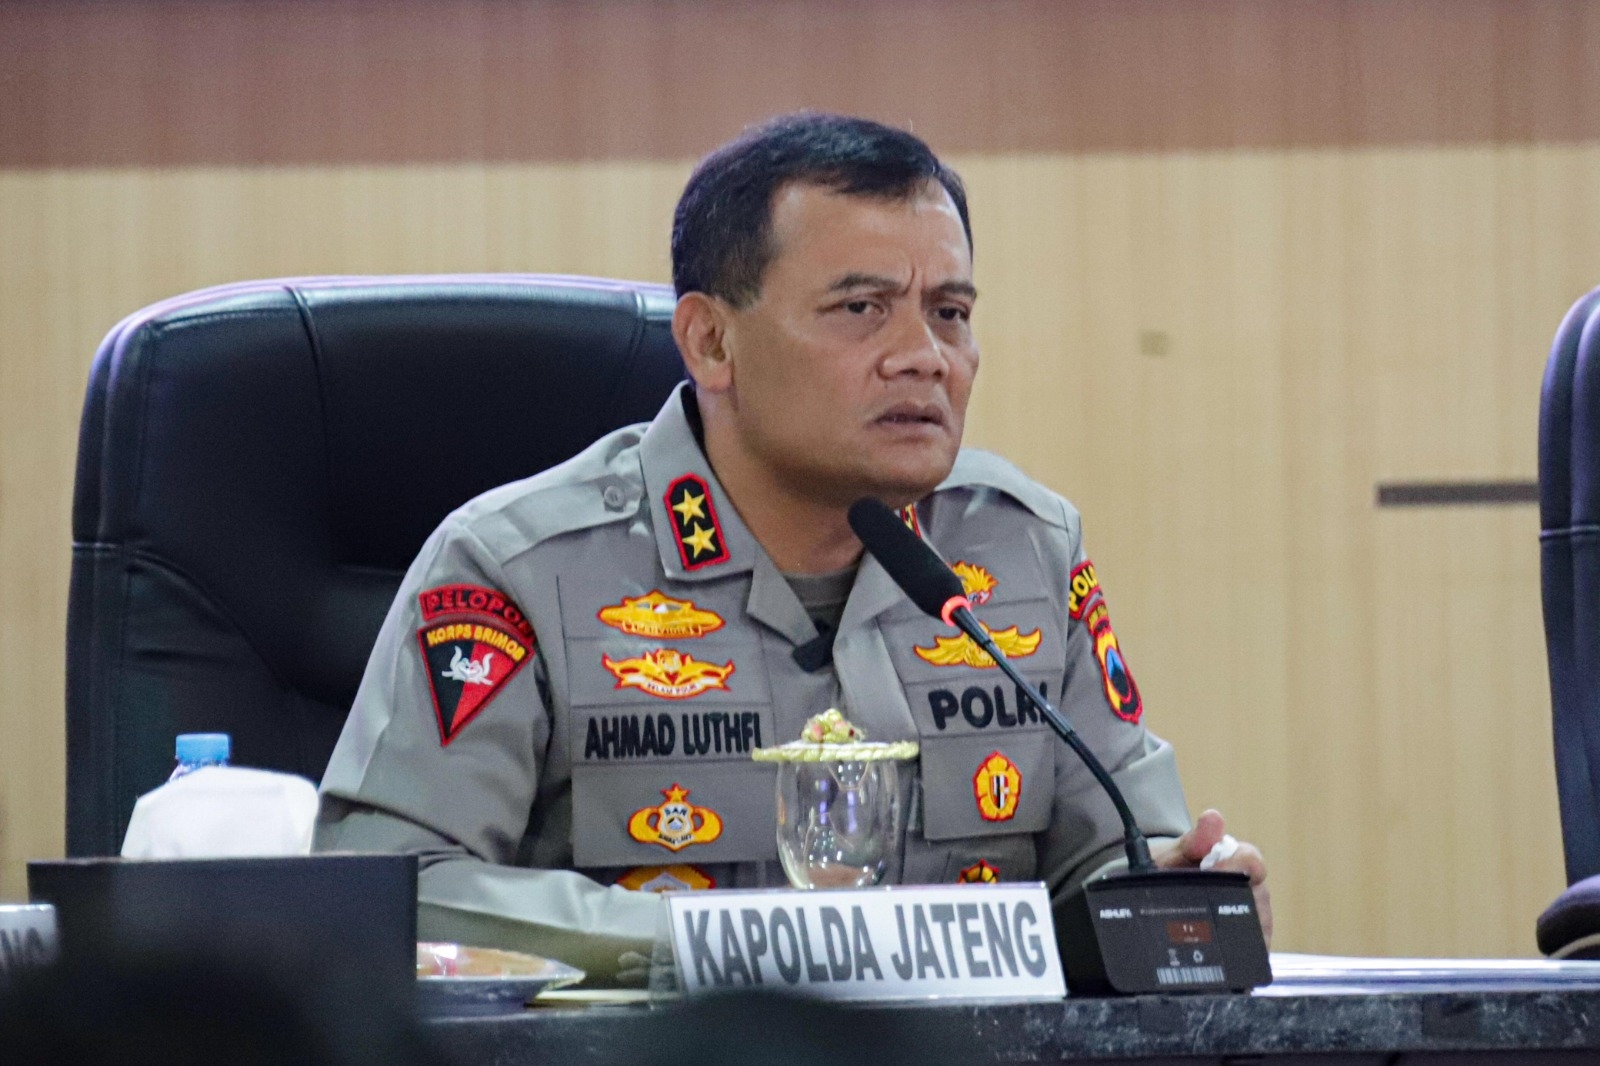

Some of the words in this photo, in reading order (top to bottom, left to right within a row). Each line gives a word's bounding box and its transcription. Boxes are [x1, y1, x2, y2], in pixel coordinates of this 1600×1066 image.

[426, 623, 473, 647] KORPS
[584, 712, 676, 760] AHMAD
[681, 711, 762, 756] LUTHFI
[683, 905, 884, 986] KAPOLDA
[890, 900, 1047, 981] JATENG
